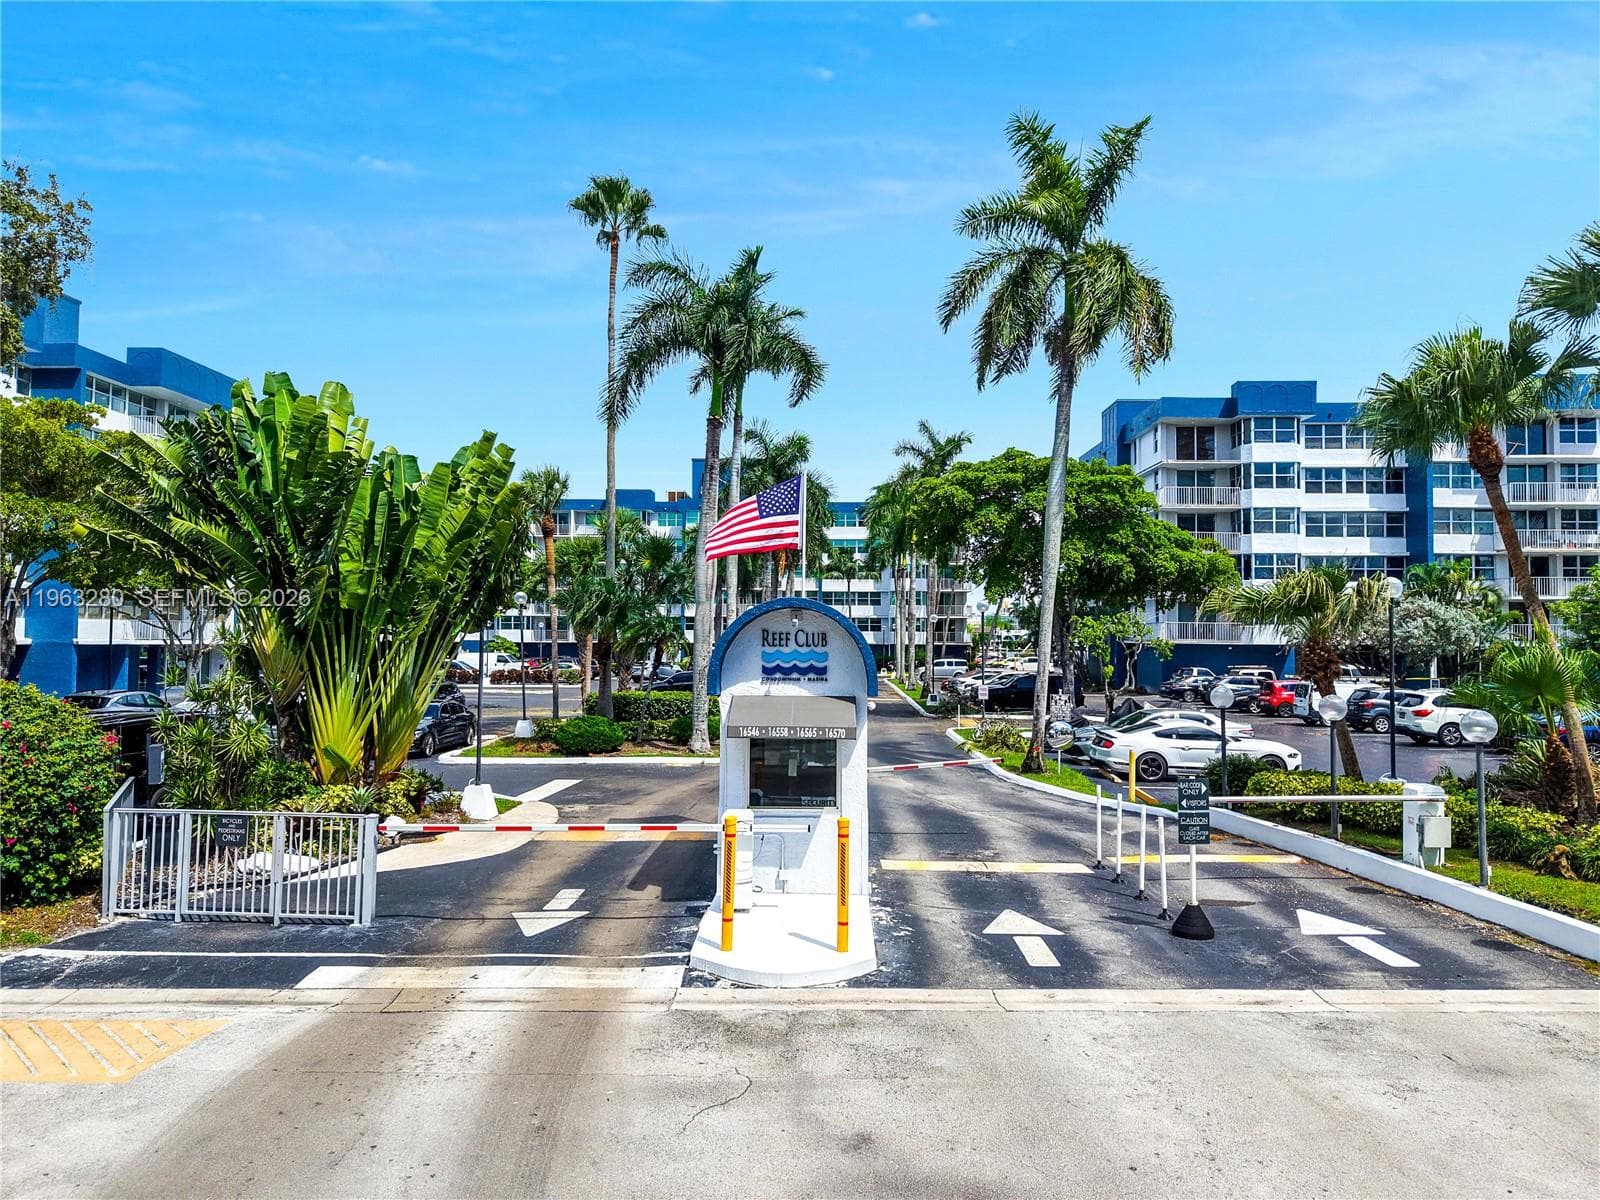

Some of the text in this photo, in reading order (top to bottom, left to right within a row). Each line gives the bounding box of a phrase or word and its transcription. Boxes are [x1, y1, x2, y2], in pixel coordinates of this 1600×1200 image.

[761, 629, 828, 647] REEF CLUB
[739, 727, 846, 738] 16546 16558 16565 16570
